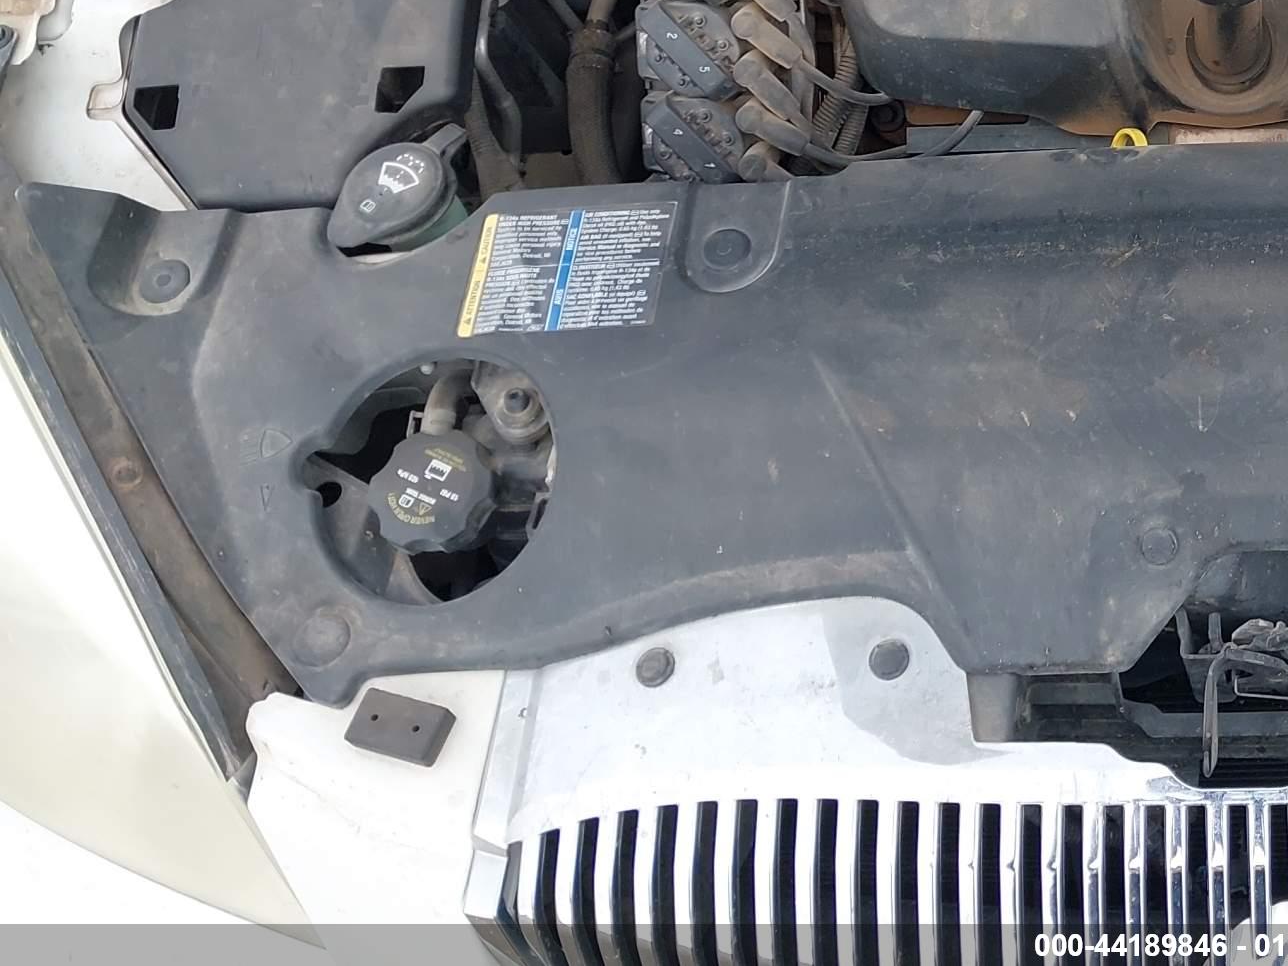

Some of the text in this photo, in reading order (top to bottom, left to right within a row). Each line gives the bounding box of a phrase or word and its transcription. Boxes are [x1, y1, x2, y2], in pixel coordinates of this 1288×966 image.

[666, 32, 678, 40] 2
[699, 66, 710, 74] 5
[672, 128, 682, 136] 4
[480, 226, 492, 256] CAUTION
[566, 228, 578, 250] NOTICE
[467, 280, 481, 316] ATTENTION
[554, 289, 564, 306] AVIS
